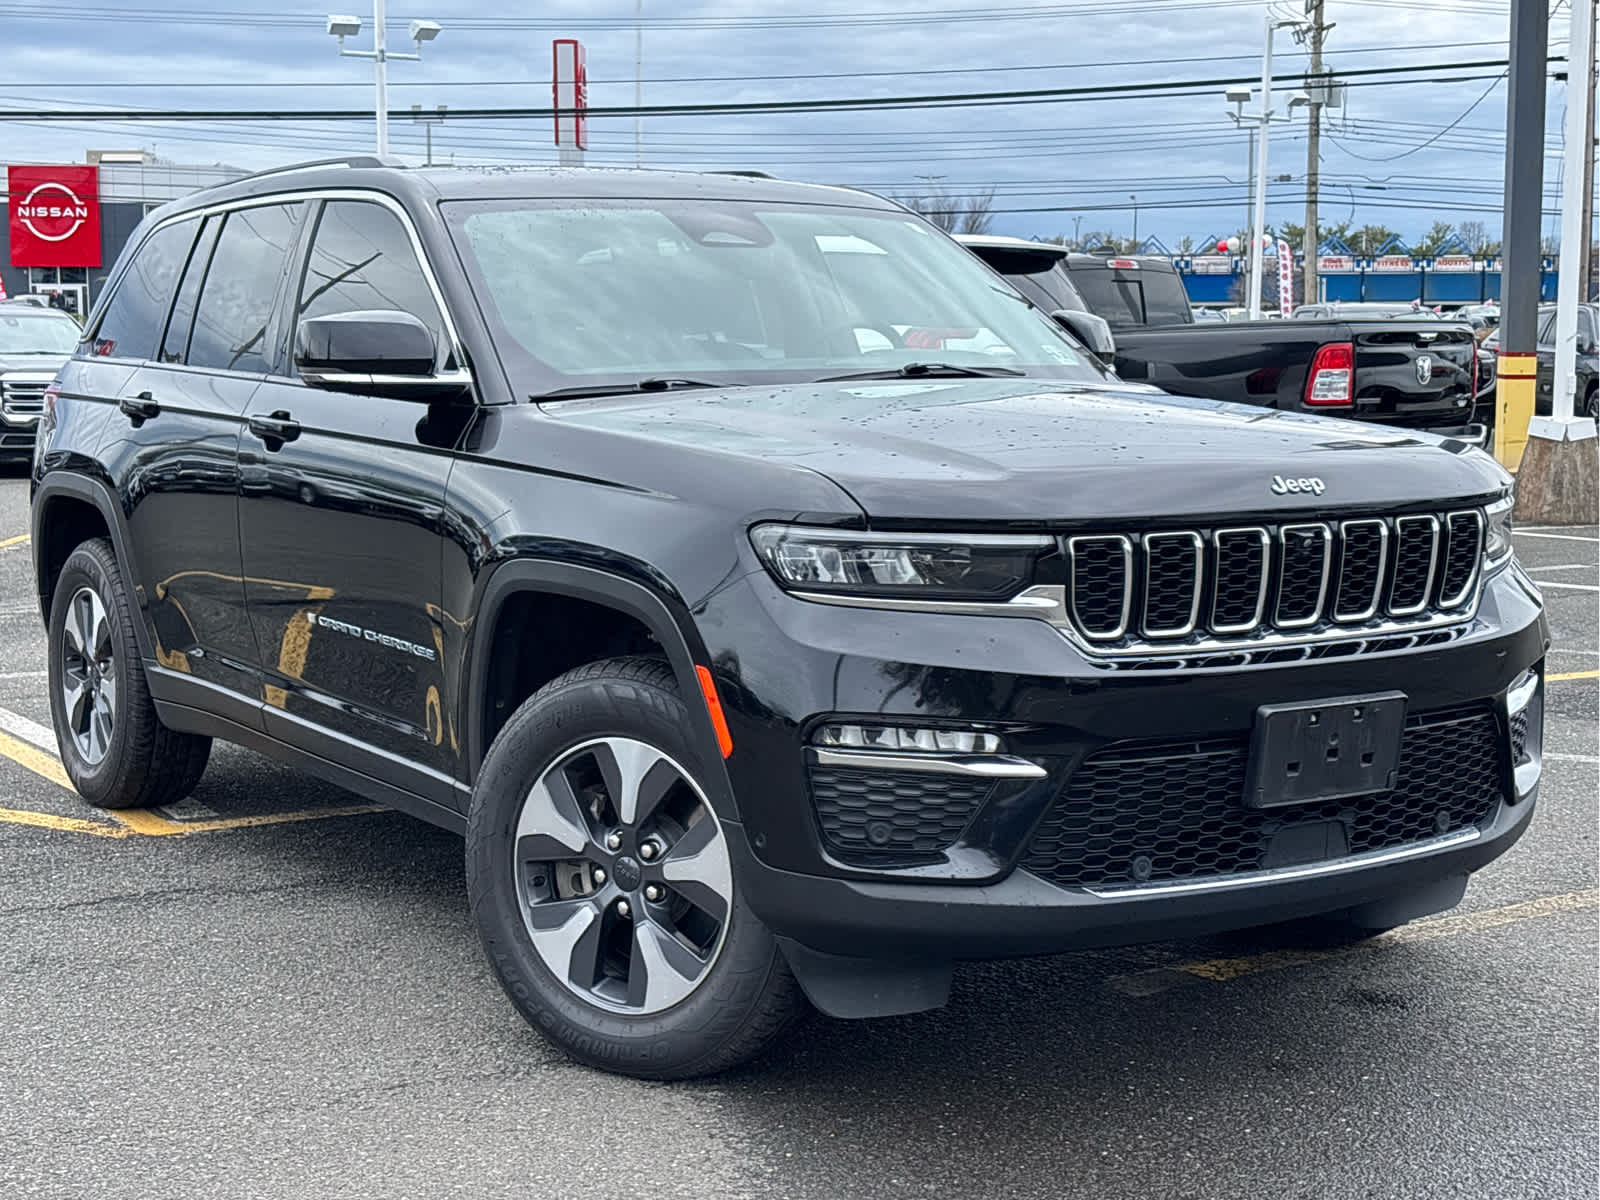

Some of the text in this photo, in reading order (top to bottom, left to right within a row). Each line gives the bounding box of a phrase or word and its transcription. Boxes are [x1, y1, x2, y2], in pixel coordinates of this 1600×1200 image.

[18, 206, 88, 218] NISSAN
[1271, 475, 1325, 496] Jeep
[318, 615, 436, 661] GRAND CHEROKEE
